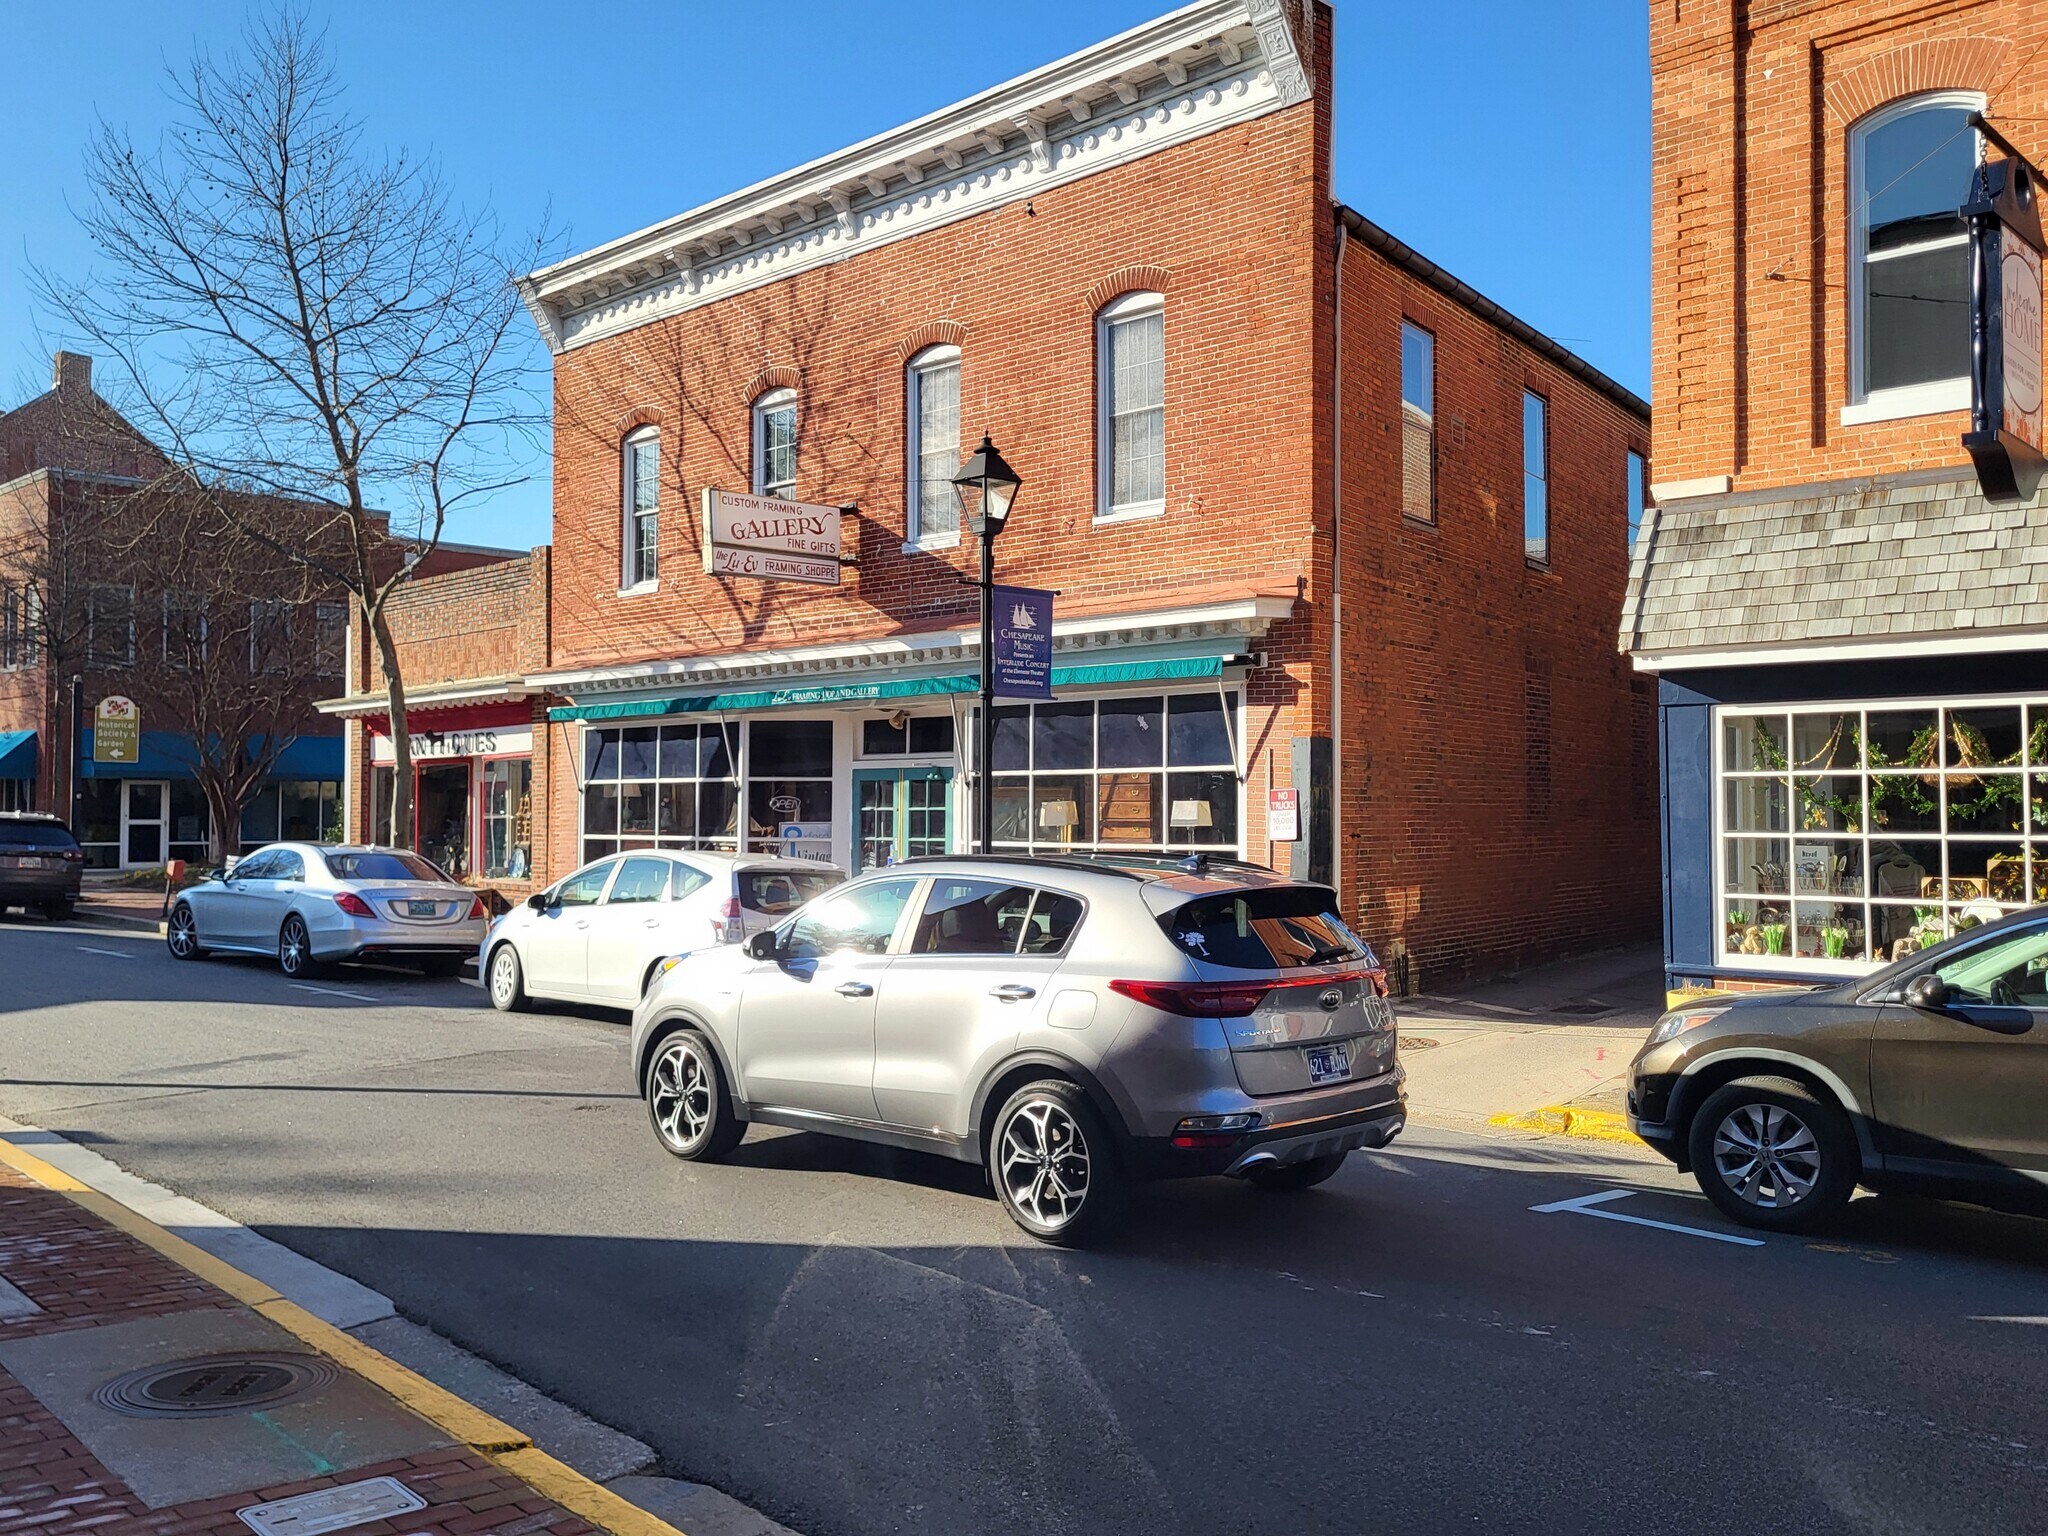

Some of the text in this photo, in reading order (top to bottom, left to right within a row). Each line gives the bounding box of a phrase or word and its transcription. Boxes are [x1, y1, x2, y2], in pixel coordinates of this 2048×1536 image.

[2006, 267, 2037, 317] welcome
[2004, 298, 2040, 354] HOME
[721, 496, 803, 515] CUSTOM FRAMING
[731, 512, 834, 540] GALLERY
[787, 538, 836, 554] FINE GIFTS
[716, 550, 728, 561] the
[765, 561, 802, 575] FRAMING
[805, 565, 835, 578] SHOPPE
[1000, 628, 1045, 642] CHESAPEAKE
[1013, 640, 1034, 651] MUSIC
[997, 657, 1050, 669] INTERLUDE CONCERT
[792, 691, 821, 701] FRAMING
[835, 688, 851, 698] AND
[851, 686, 880, 696] GALLERY
[98, 721, 135, 729] Historical
[98, 729, 128, 738] Society
[1277, 792, 1288, 800] NO
[769, 798, 802, 810] OPEN
[1271, 801, 1295, 810] TRUCKS
[1273, 817, 1294, 825] 10,000
[797, 849, 832, 863] Vintag
[1310, 1057, 1326, 1076] 621
